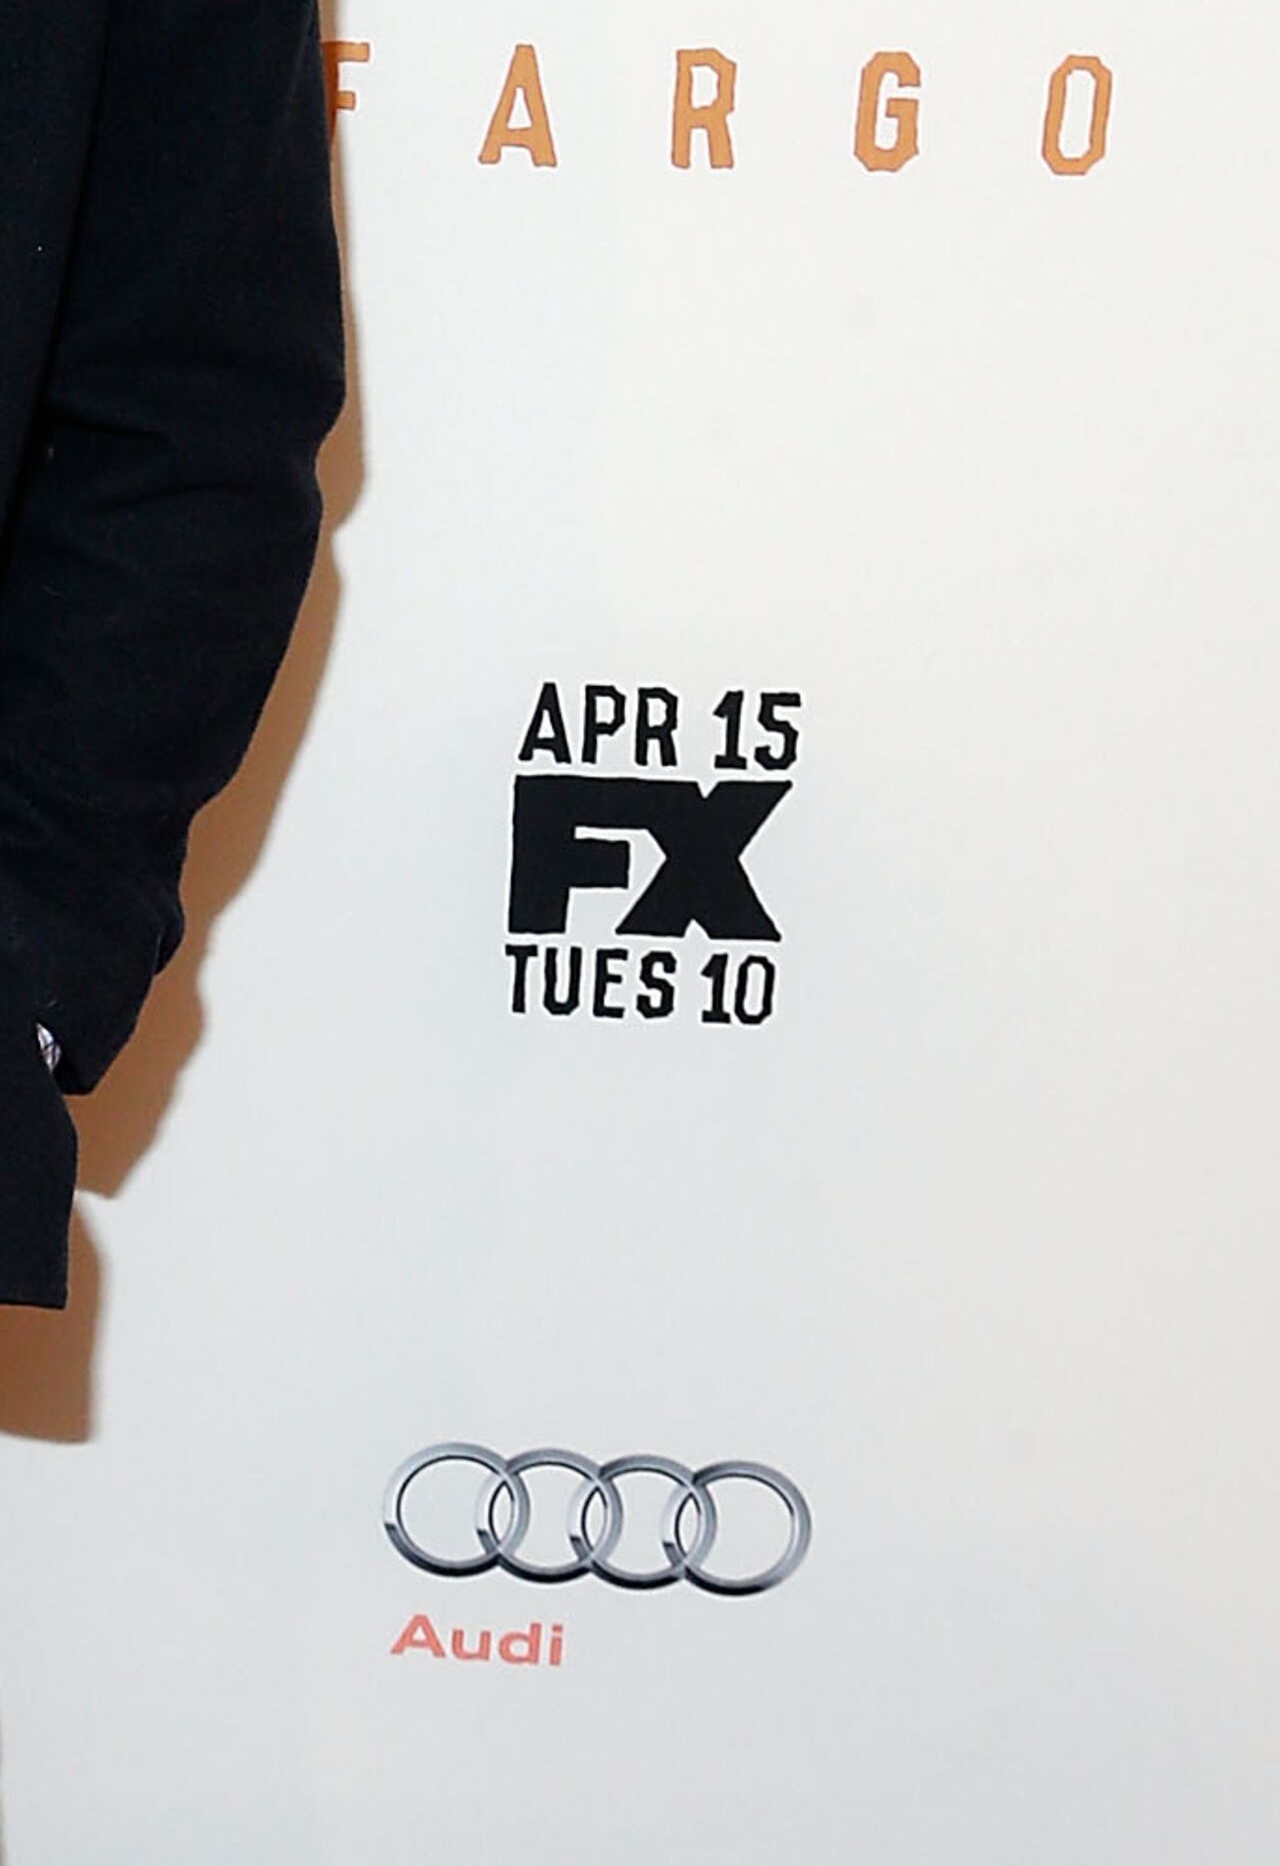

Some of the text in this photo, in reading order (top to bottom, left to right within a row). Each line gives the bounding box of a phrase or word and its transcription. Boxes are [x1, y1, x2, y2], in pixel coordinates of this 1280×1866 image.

[322, 41, 1113, 176] FARGO
[518, 682, 802, 771] APR 15
[508, 775, 793, 943] FX
[505, 943, 775, 1025] TUES 10
[391, 1613, 565, 1668] Audi
